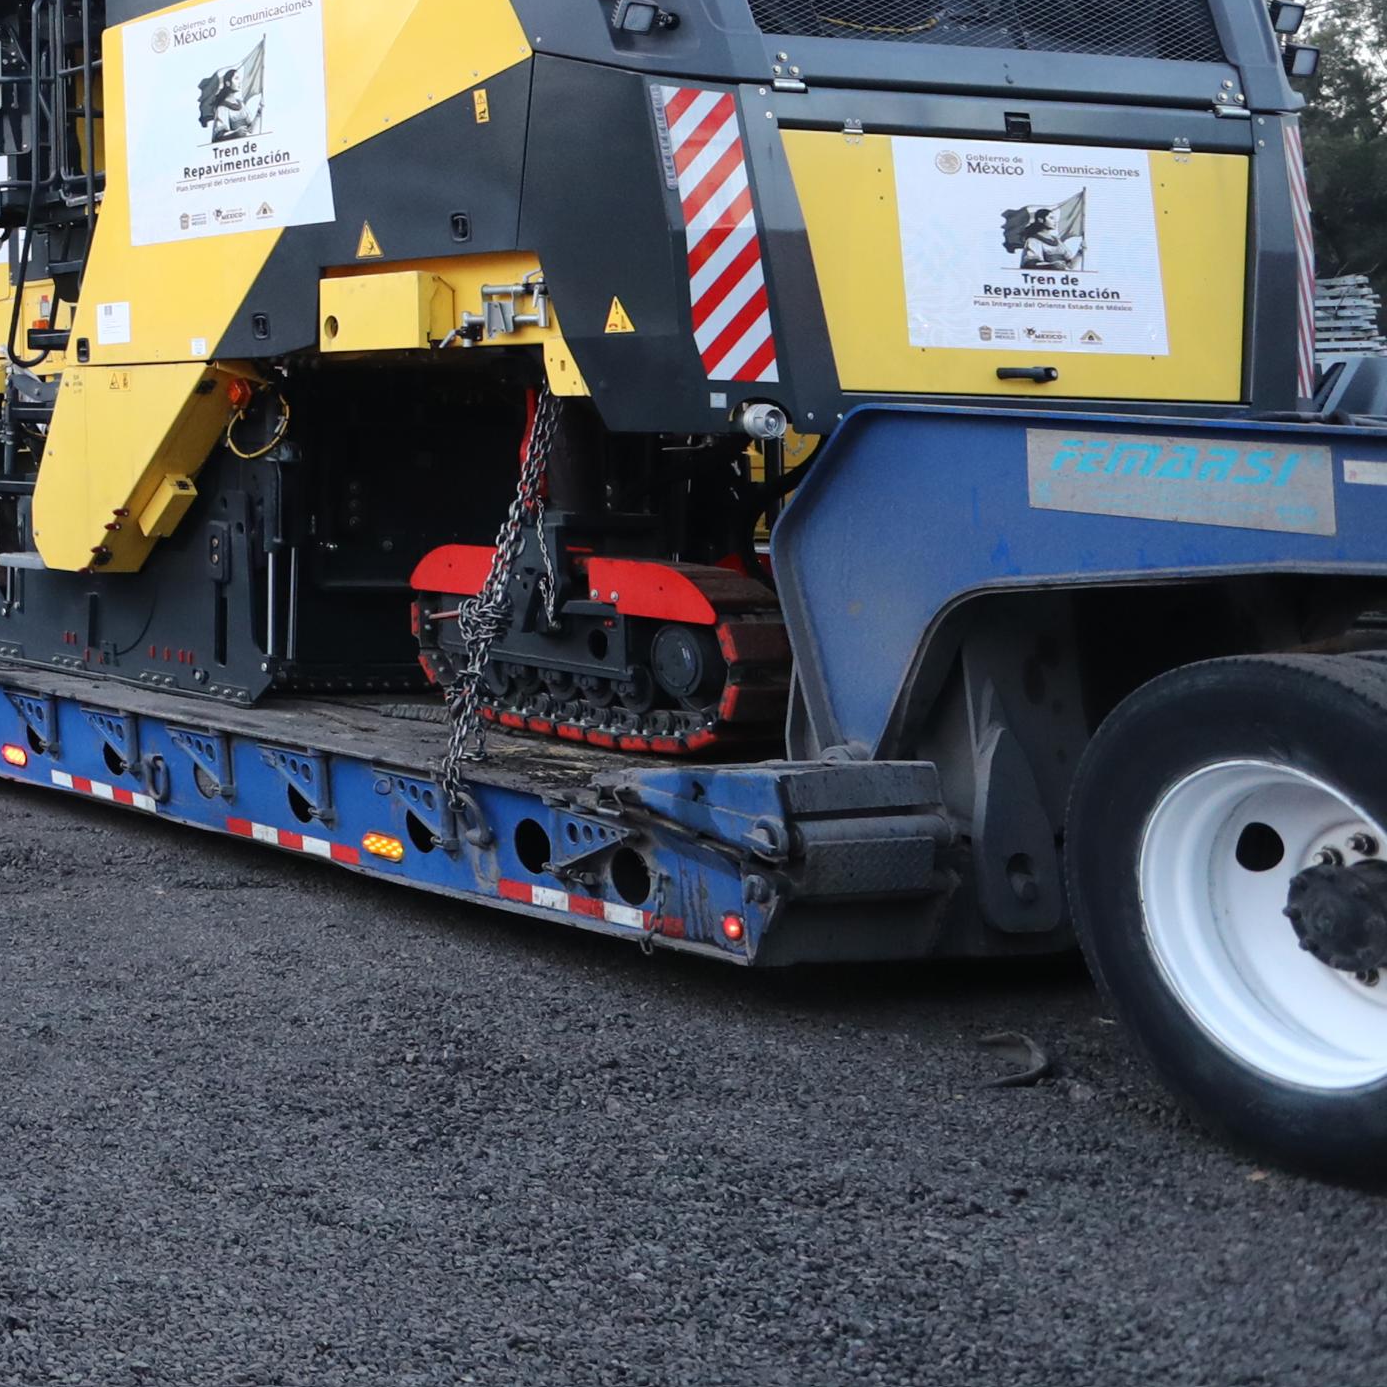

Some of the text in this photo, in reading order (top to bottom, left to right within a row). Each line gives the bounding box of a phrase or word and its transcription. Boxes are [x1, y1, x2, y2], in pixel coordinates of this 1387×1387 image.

[173, 16, 216, 34] Gobierno de
[173, 26, 217, 47] México
[212, 141, 258, 159] Tren de
[966, 154, 1023, 163] Gobierno de
[183, 150, 291, 180] Repavimentación
[967, 161, 1025, 176] México
[1041, 163, 1140, 178] Comunicaciones
[1022, 273, 1079, 286] Tren de
[983, 284, 1121, 300] Repavimentación
[1050, 438, 1303, 487] FEMARSI
